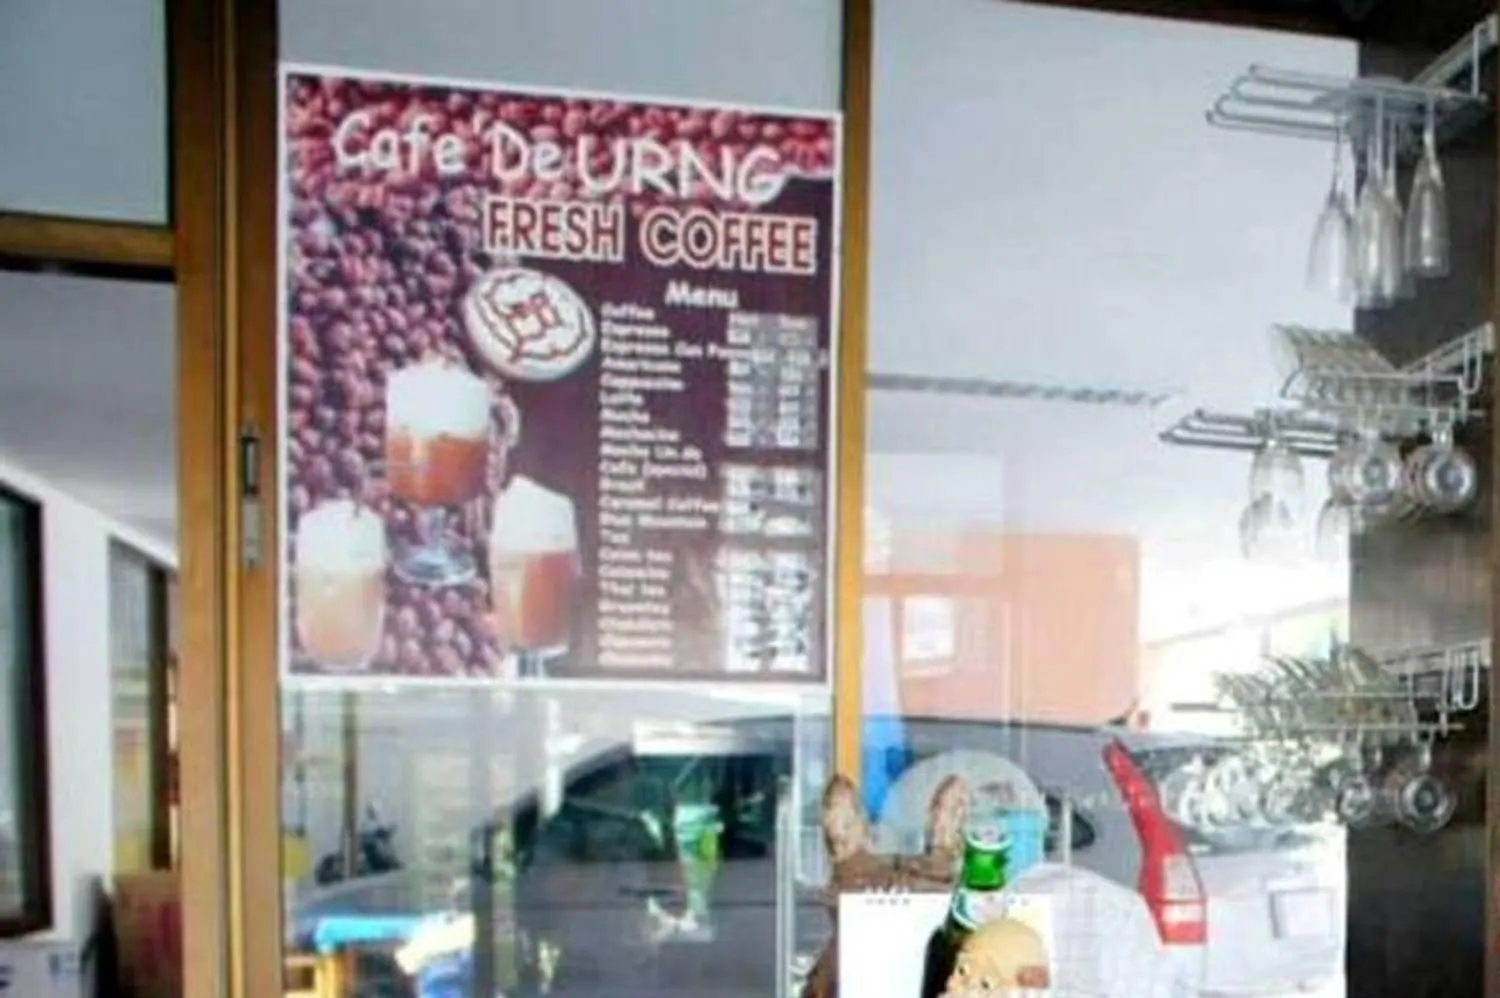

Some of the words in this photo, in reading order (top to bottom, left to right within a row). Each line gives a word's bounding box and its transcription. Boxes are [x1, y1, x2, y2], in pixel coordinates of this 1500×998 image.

[331, 109, 466, 176] Cafe
[484, 197, 626, 263] FRESH
[639, 206, 818, 275] COFFEE
[664, 279, 739, 308] Menu
